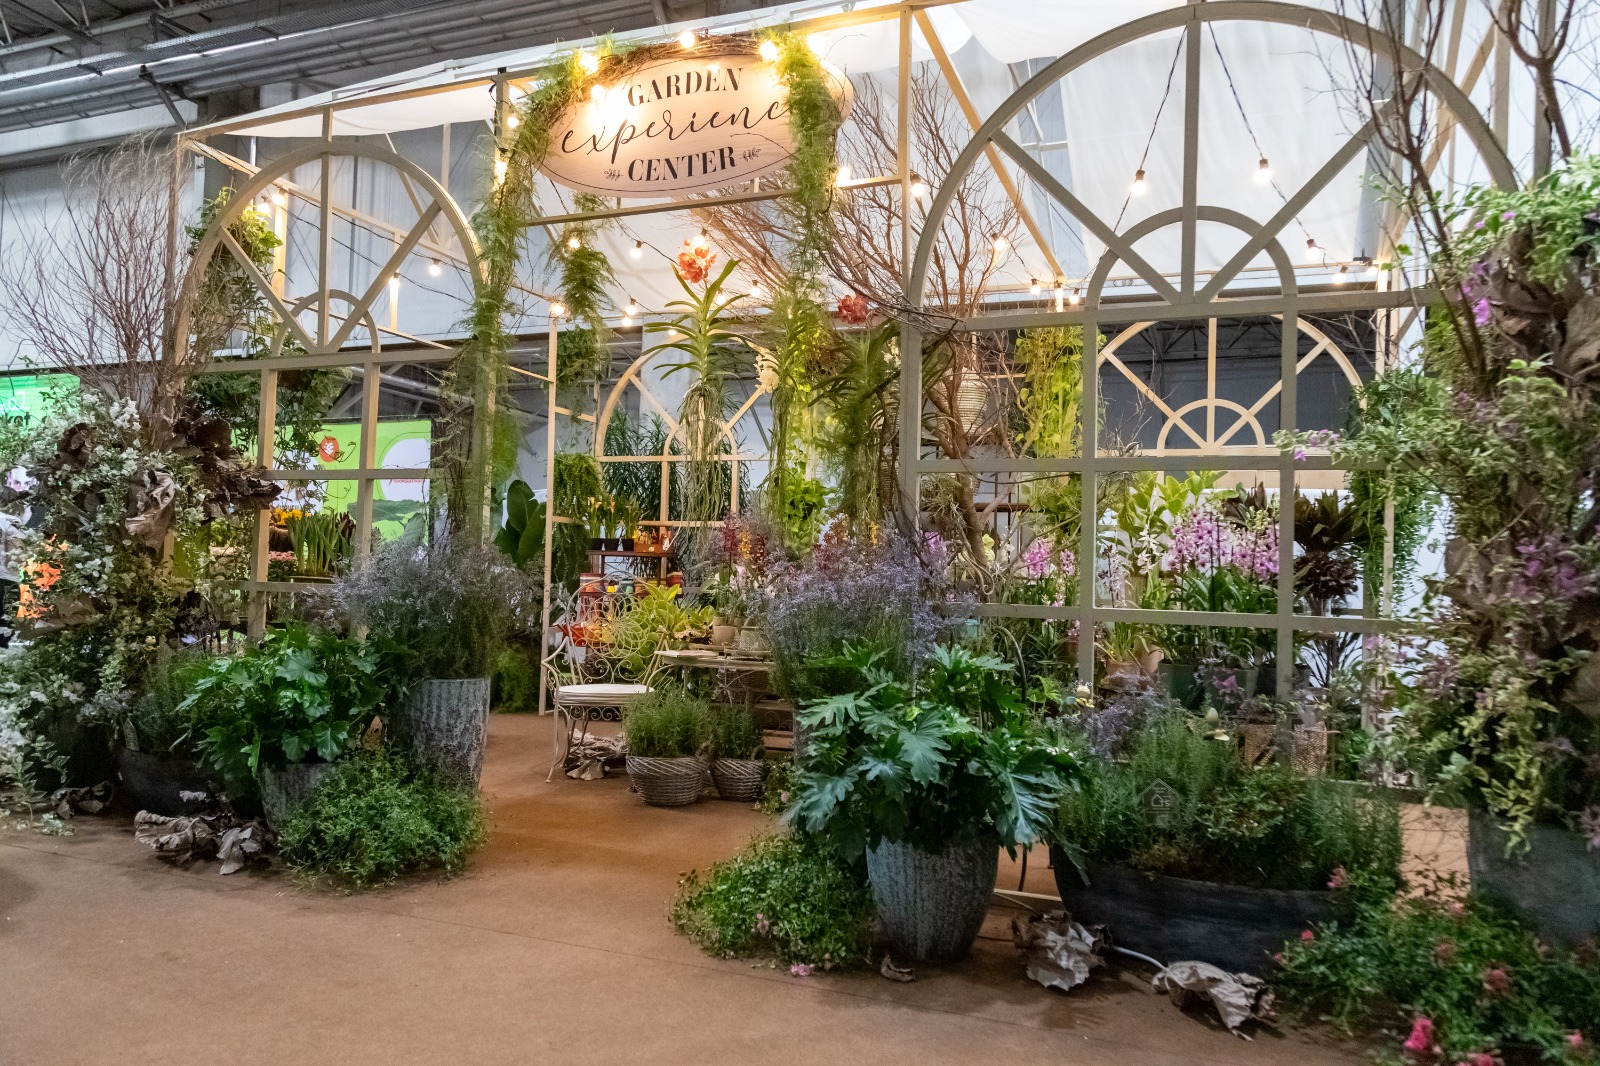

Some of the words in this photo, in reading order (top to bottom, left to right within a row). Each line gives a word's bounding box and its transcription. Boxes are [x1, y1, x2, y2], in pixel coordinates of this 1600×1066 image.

[627, 67, 743, 107] GARDEN
[561, 100, 790, 164] experienc
[628, 145, 736, 182] CENTER
